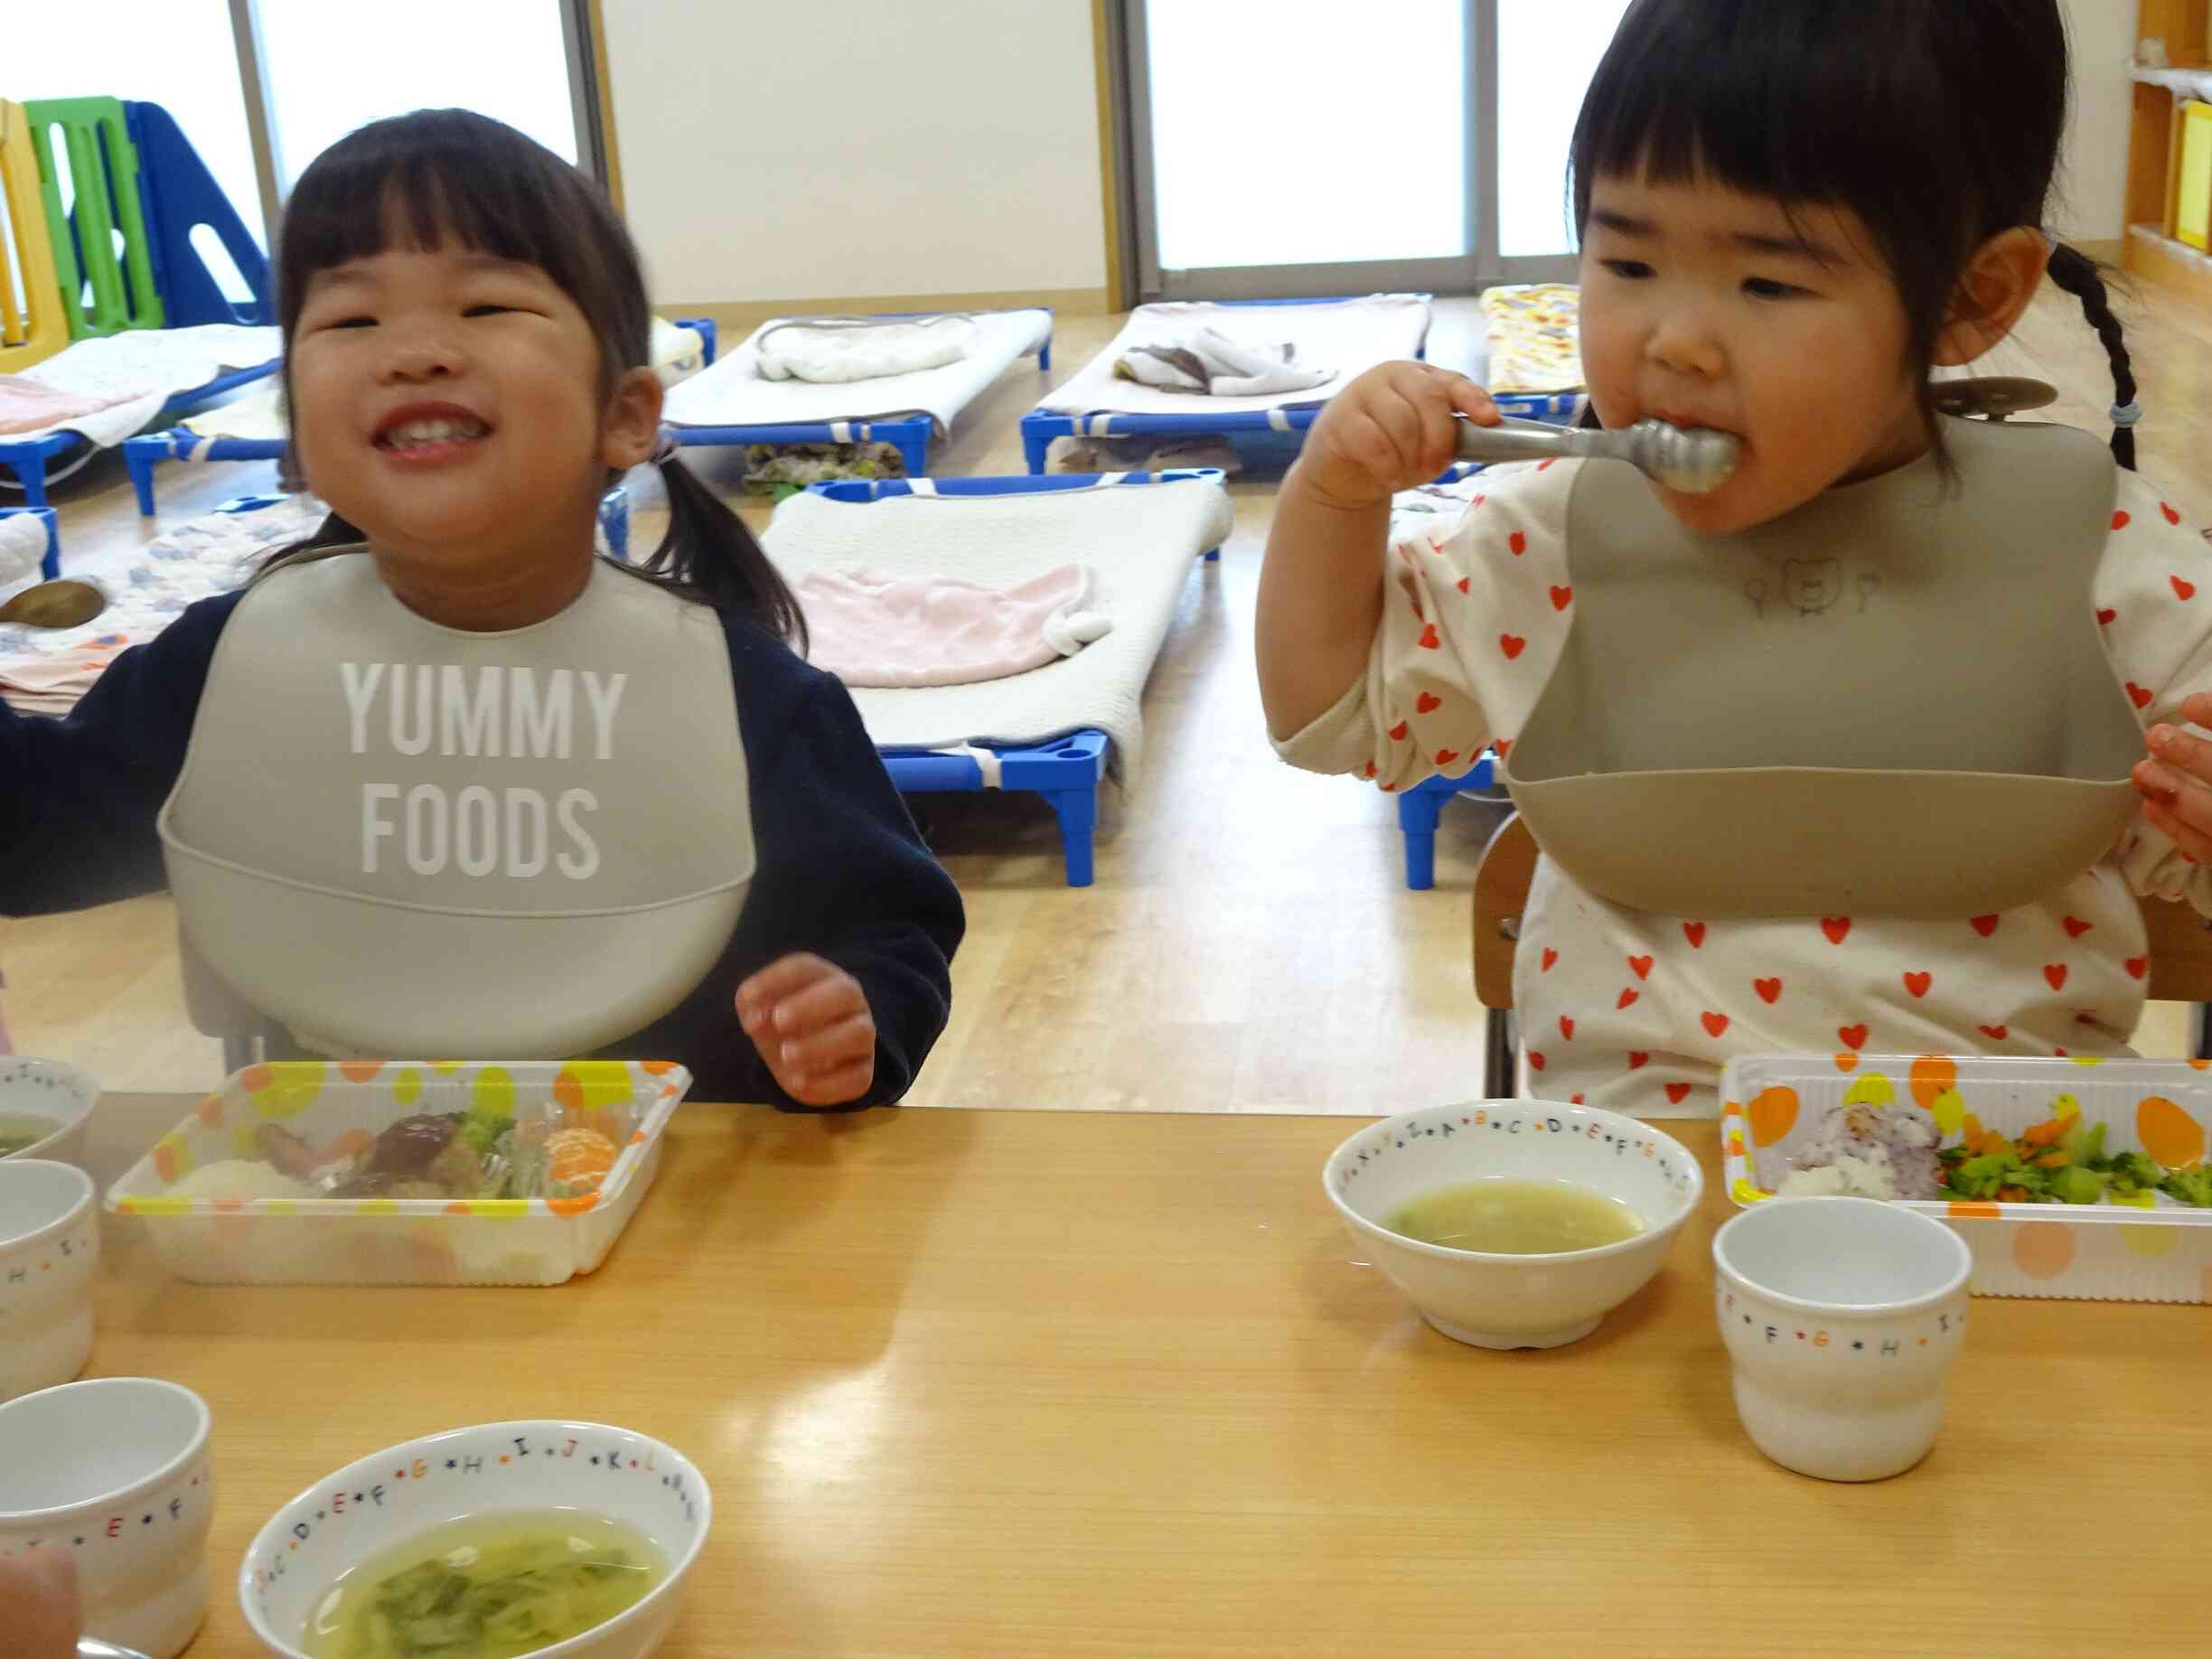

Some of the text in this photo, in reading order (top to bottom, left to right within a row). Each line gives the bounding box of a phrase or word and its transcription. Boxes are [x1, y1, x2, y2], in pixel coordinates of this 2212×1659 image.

[339, 662, 629, 759] YUMMY
[361, 783, 601, 880] FOODS
[1508, 1120, 1522, 1134] C
[1547, 1118, 1562, 1133] D
[1587, 1123, 1600, 1139] E
[1616, 1139, 1627, 1156] F
[1765, 1326, 1778, 1344] F
[332, 1492, 346, 1514] E
[370, 1484, 384, 1506] F
[410, 1457, 428, 1480] G
[463, 1455, 483, 1474] H
[512, 1437, 530, 1457] I
[560, 1438, 579, 1458] J
[607, 1449, 622, 1470] K
[106, 1517, 125, 1538] E
